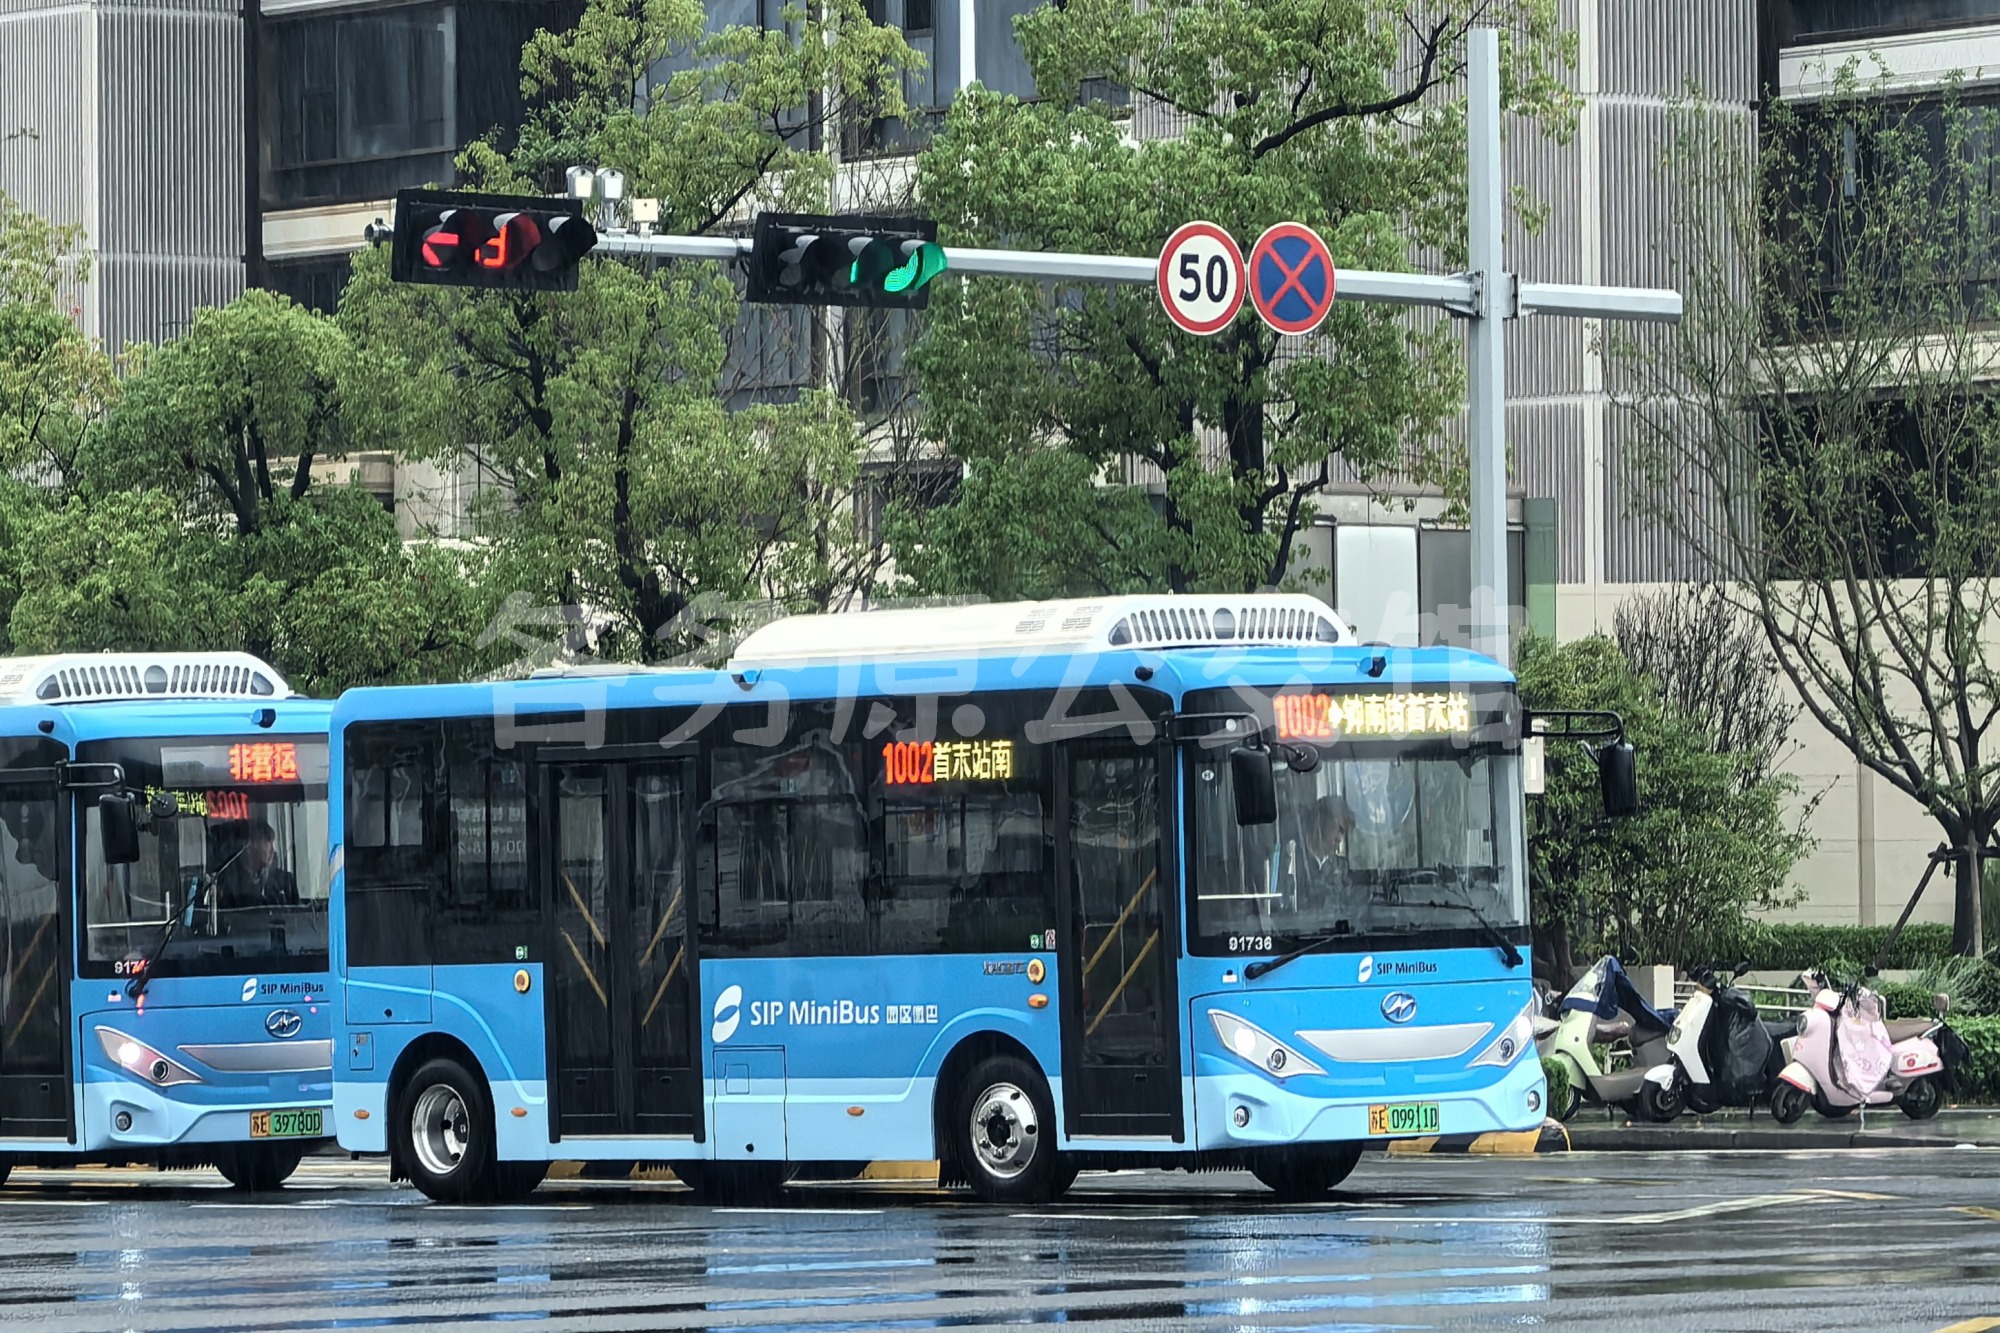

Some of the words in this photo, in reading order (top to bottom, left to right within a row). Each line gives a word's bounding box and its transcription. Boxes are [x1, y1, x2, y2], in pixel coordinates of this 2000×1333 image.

[1179, 253, 1228, 303] 50
[1273, 694, 1331, 738] 1002
[228, 743, 297, 781] 非营运
[882, 740, 933, 784] 1002
[933, 740, 1013, 781] 首末站南
[1376, 961, 1393, 975] SIP
[1395, 961, 1438, 975] MiniBus
[261, 983, 278, 995] SIP
[280, 982, 324, 994] MiniBus
[751, 1001, 784, 1025] SIP
[789, 1000, 880, 1025] MiniBus
